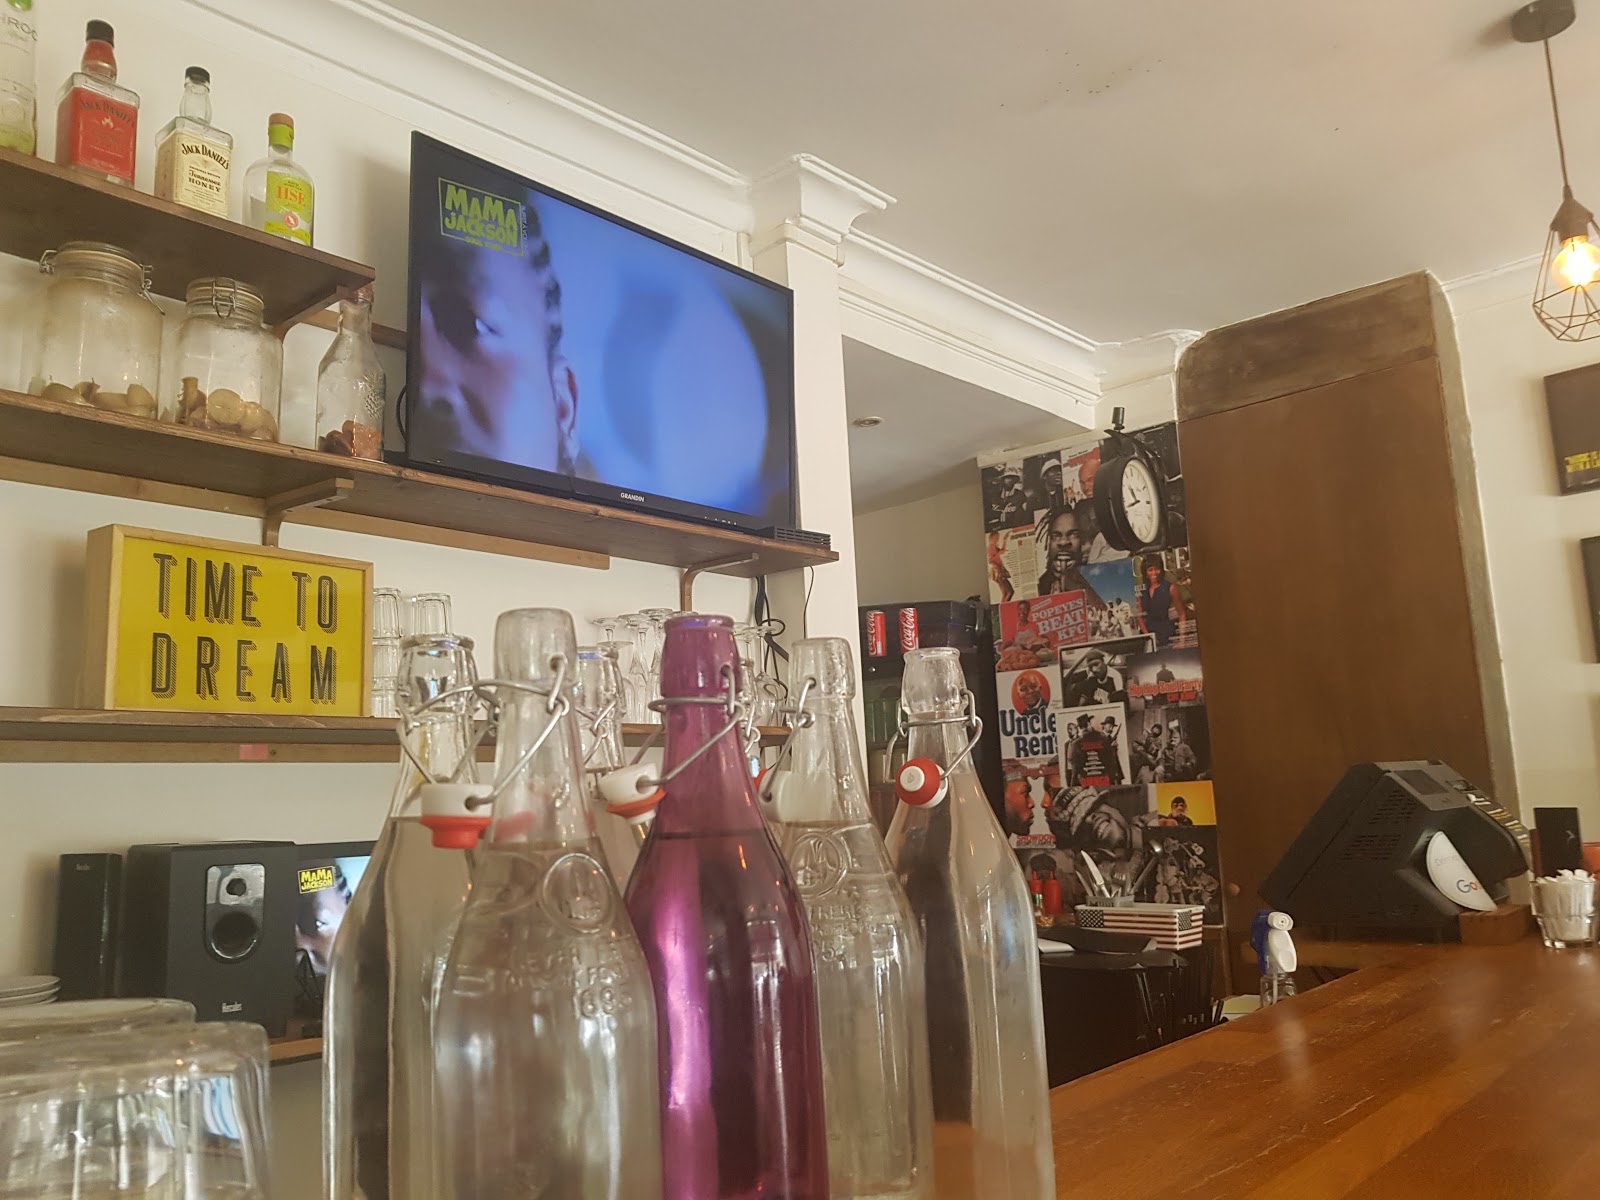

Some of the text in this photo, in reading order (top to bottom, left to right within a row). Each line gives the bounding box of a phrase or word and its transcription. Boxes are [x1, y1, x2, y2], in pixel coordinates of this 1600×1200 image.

[181, 143, 201, 156] JACK
[188, 177, 221, 193] HONEY
[445, 184, 518, 230] MAMA
[445, 211, 518, 248] JACKSON
[620, 492, 645, 502] GRANDIN
[153, 552, 338, 634] TIME TO
[1031, 599, 1083, 621] POPEYES
[1037, 609, 1084, 636] BEAT
[1056, 623, 1086, 640] KFC
[151, 632, 338, 705] DREAM
[999, 706, 1056, 736] Uncle
[301, 869, 332, 883] MAMA
